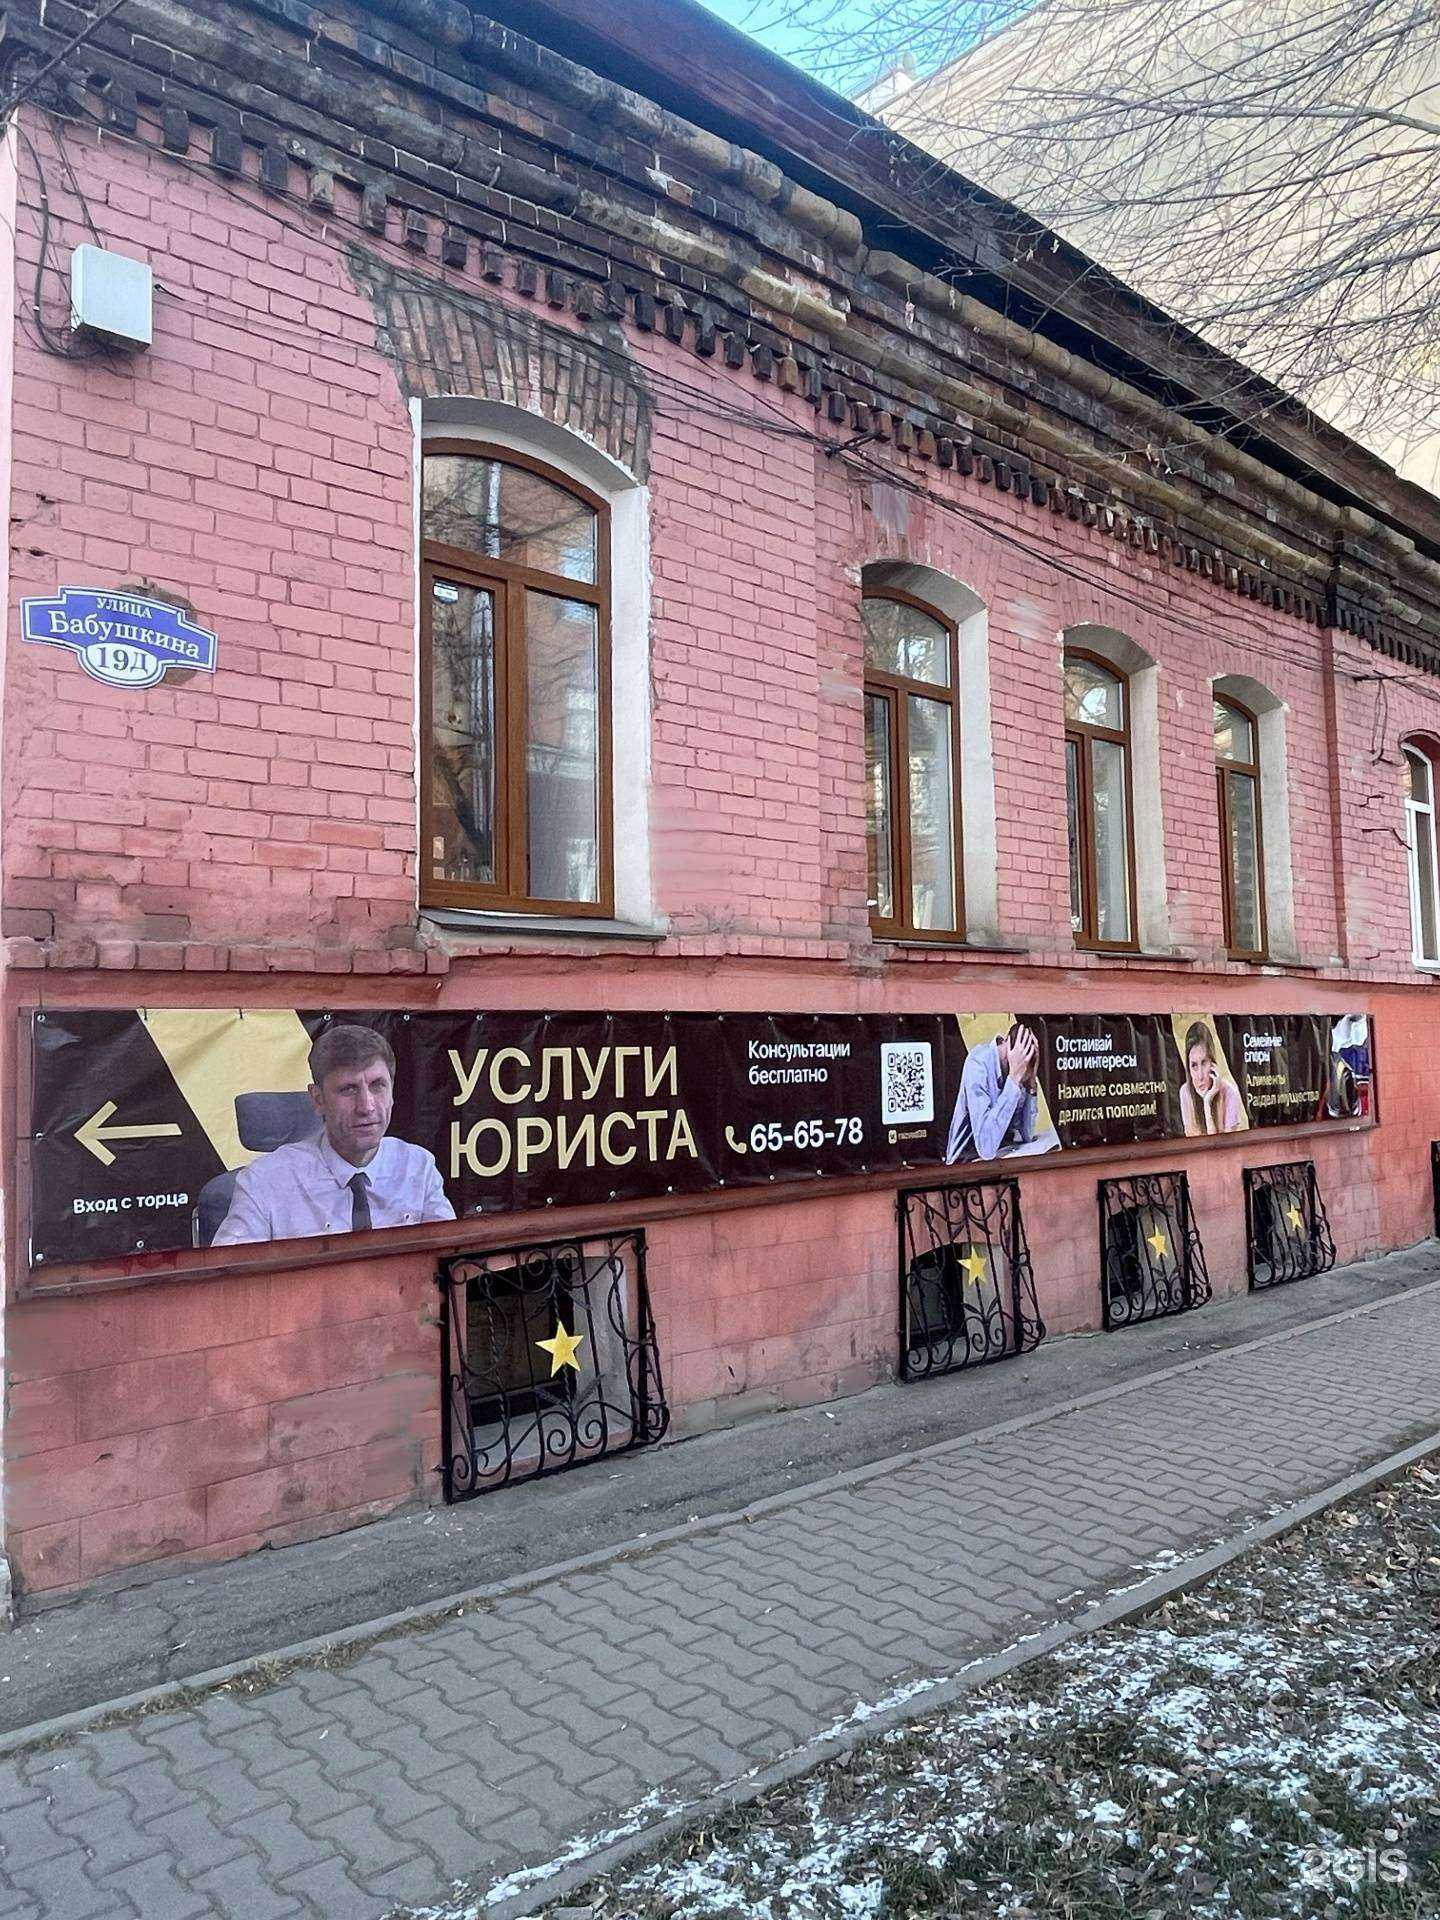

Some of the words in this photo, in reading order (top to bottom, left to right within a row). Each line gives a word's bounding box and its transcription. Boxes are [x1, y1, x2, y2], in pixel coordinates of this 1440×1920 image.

[47, 610, 200, 659] Бабушкина
[1055, 1033, 1112, 1053] Отстаивай
[1243, 1032, 1283, 1048] Семейне
[748, 1040, 851, 1062] Консультации
[1056, 1056, 1082, 1071] свои
[1083, 1055, 1138, 1072] интересы
[448, 1046, 678, 1106] УСЛУГИ
[748, 1065, 828, 1085] бесплатно
[1108, 1081, 1167, 1097] совместно
[1058, 1106, 1104, 1126] делится
[450, 1109, 699, 1178] ЮРИСТА
[750, 1117, 864, 1152] 65-65-78
[73, 1198, 118, 1214] Вход
[121, 1197, 132, 1209] с
[136, 1193, 189, 1209] торца
